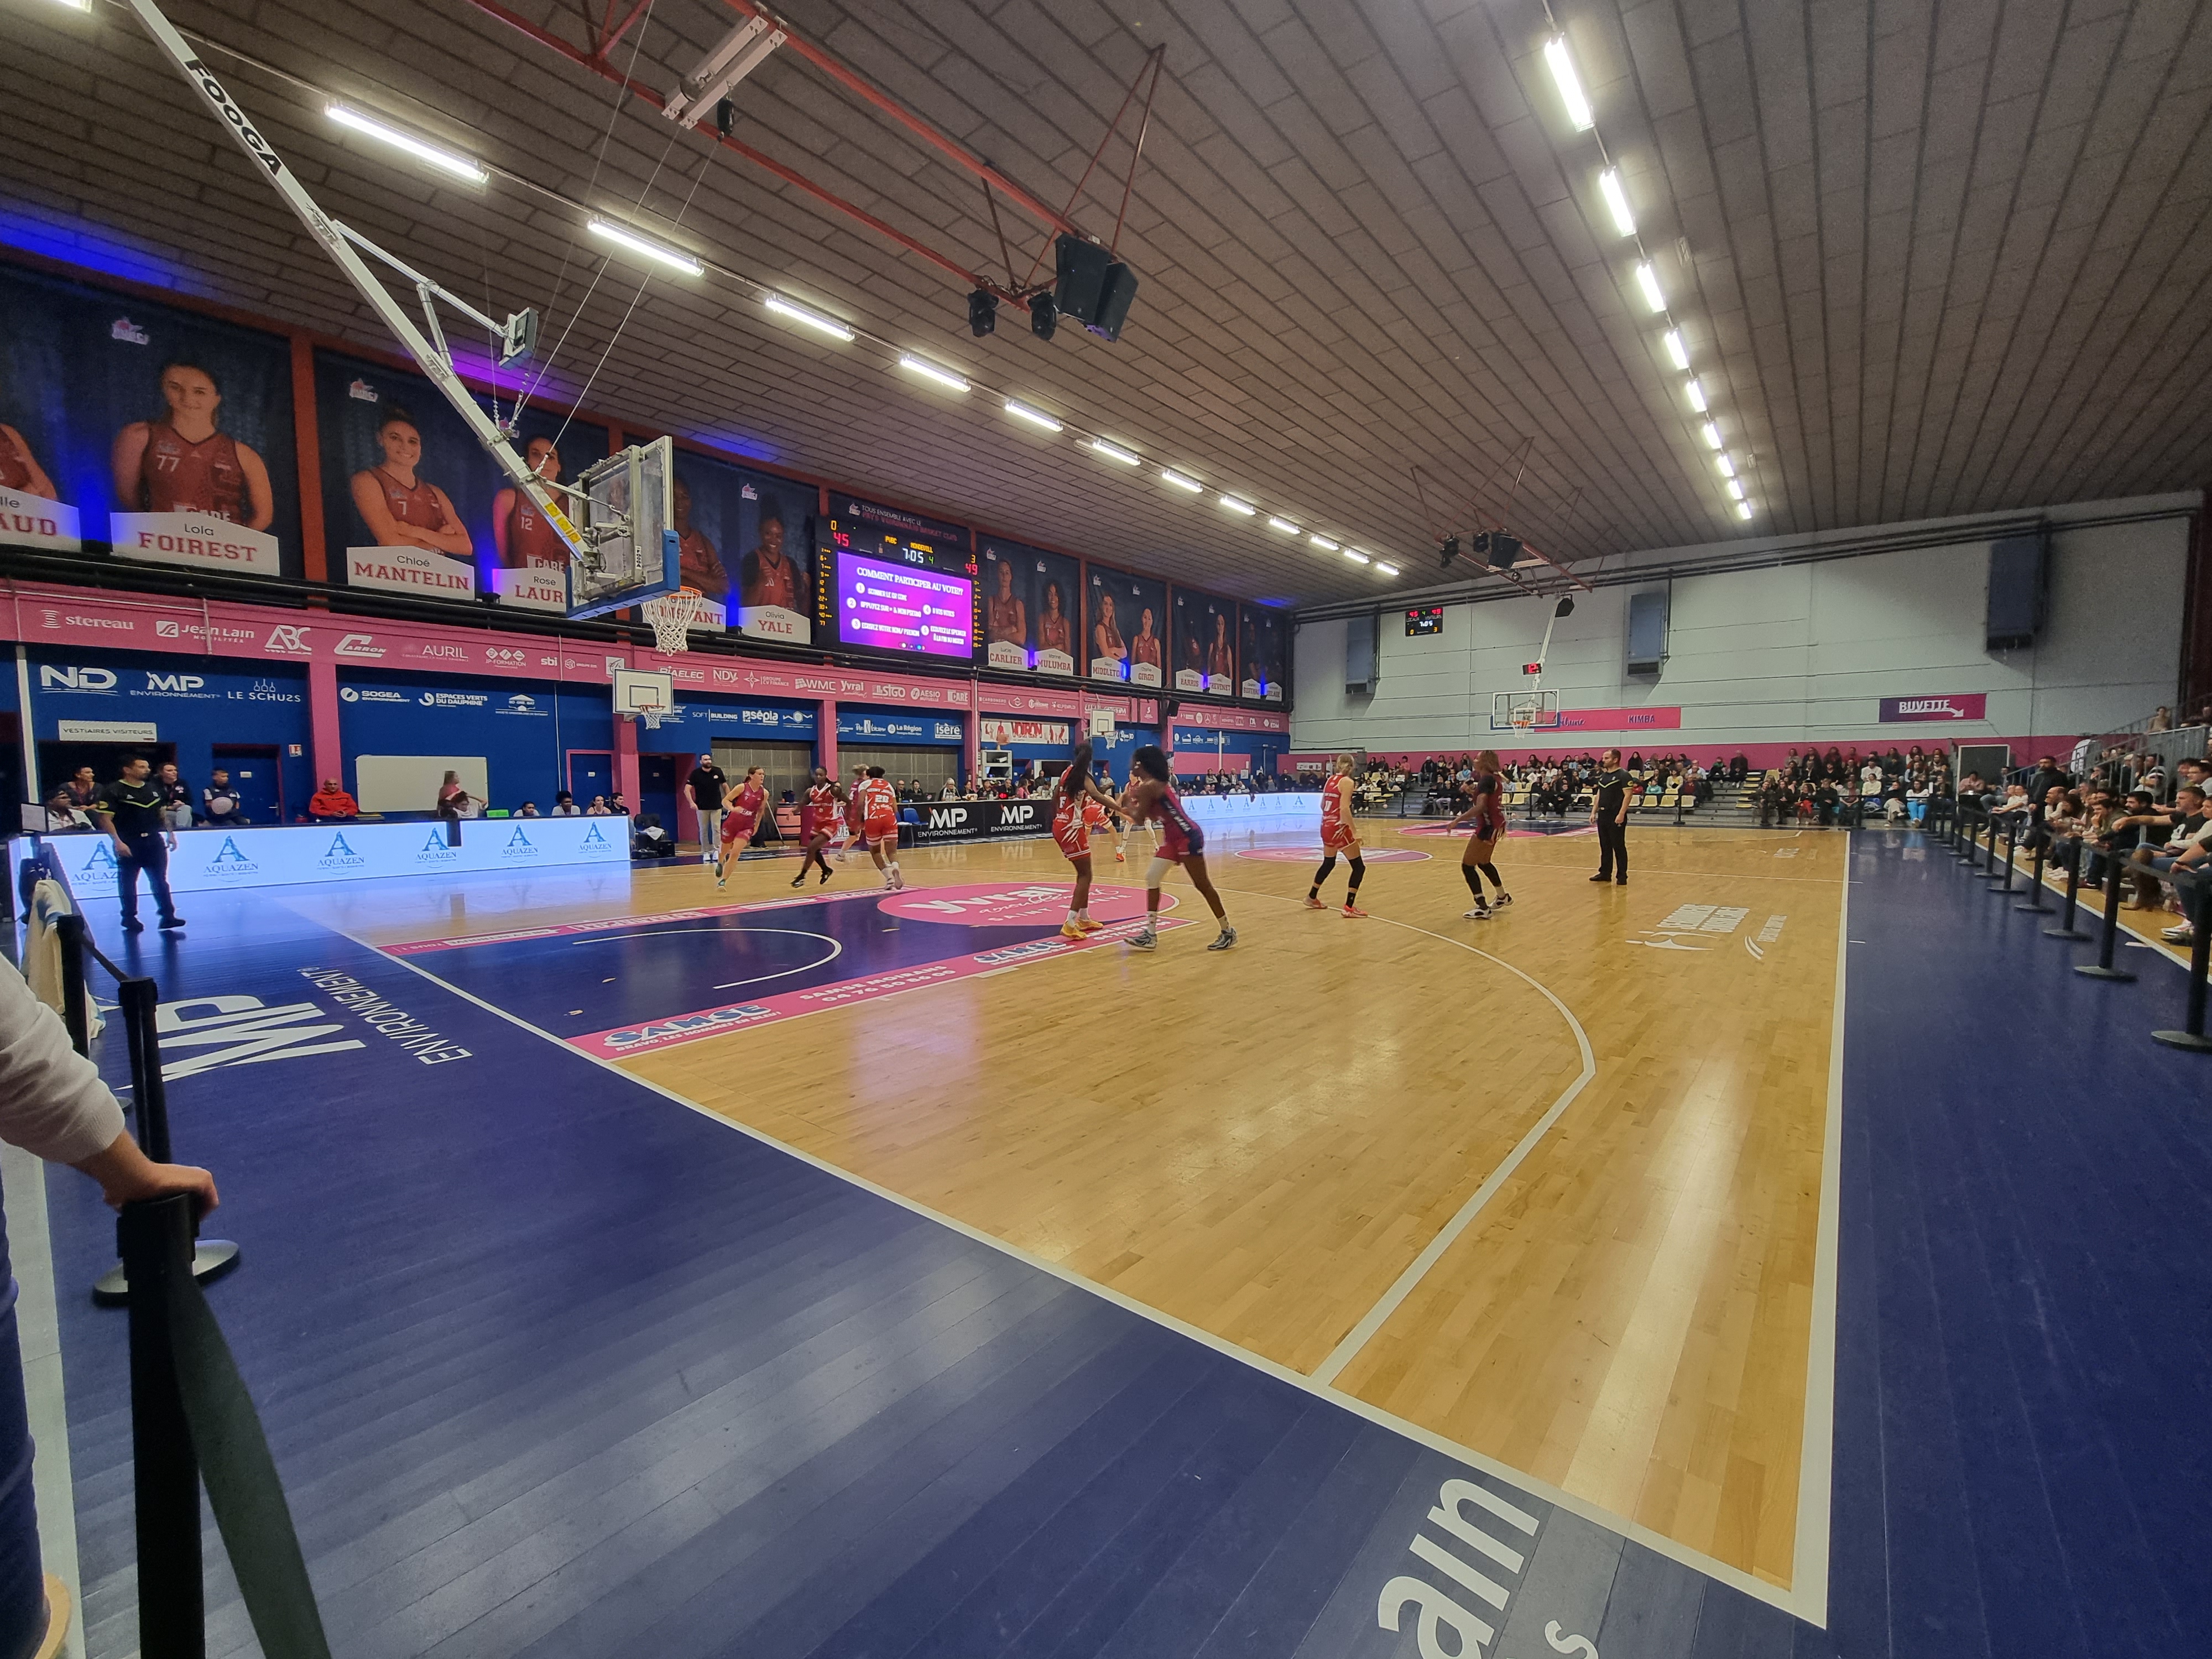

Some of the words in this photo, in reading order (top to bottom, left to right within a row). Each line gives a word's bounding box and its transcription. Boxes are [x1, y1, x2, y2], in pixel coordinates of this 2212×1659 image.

[157, 456, 180, 472] 77
[185, 524, 214, 536] Lola
[521, 517, 532, 530] 12
[831, 520, 836, 530] 0
[138, 531, 257, 561] FOIREST
[833, 532, 850, 547] 45
[397, 555, 430, 567] Chloé
[902, 547, 924, 564] 7:05
[971, 555, 975, 563] 3
[354, 561, 469, 590] MANTELIN
[966, 563, 978, 575] 49
[534, 576, 556, 585] Rose
[857, 567, 894, 582] COMMENT
[894, 575, 931, 589] PARTICIPER
[932, 582, 941, 591] AU
[66, 615, 134, 630] stereau
[758, 619, 792, 634] YALE
[265, 625, 312, 651] ABC
[422, 645, 469, 659] AURIL
[541, 656, 557, 666] sbi
[990, 653, 1022, 665] CARLIER
[1037, 659, 1071, 671] MULUMBA
[40, 665, 117, 689] ND
[1093, 666, 1124, 677] MIDDLETO
[1138, 672, 1155, 681] GIROD
[147, 671, 204, 691] MP
[806, 679, 836, 690] WMC
[228, 691, 243, 700] LE
[436, 693, 465, 701] ESPACES
[1898, 700, 1950, 713] BUVETTE
[1627, 714, 1655, 724] KIMBA
[936, 722, 961, 735] isère
[929, 806, 968, 829] MP
[1001, 804, 1034, 824] MP
[415, 852, 457, 861] AQUAZEN
[502, 847, 539, 855] AQUAZEN
[204, 863, 258, 873] AQUAZEN
[317, 857, 365, 866] AQUAZEN
[71, 872, 118, 881] AQUAZ
[988, 907, 1053, 921] SAINT
[973, 940, 1067, 964] SAMSE
[800, 982, 866, 1000] SAMSE
[866, 965, 947, 985] MOIRANS
[822, 993, 852, 1001] 04
[603, 1005, 771, 1046] SAMSE
[662, 1032, 684, 1042] LES
[684, 1021, 734, 1037] HOMMES
